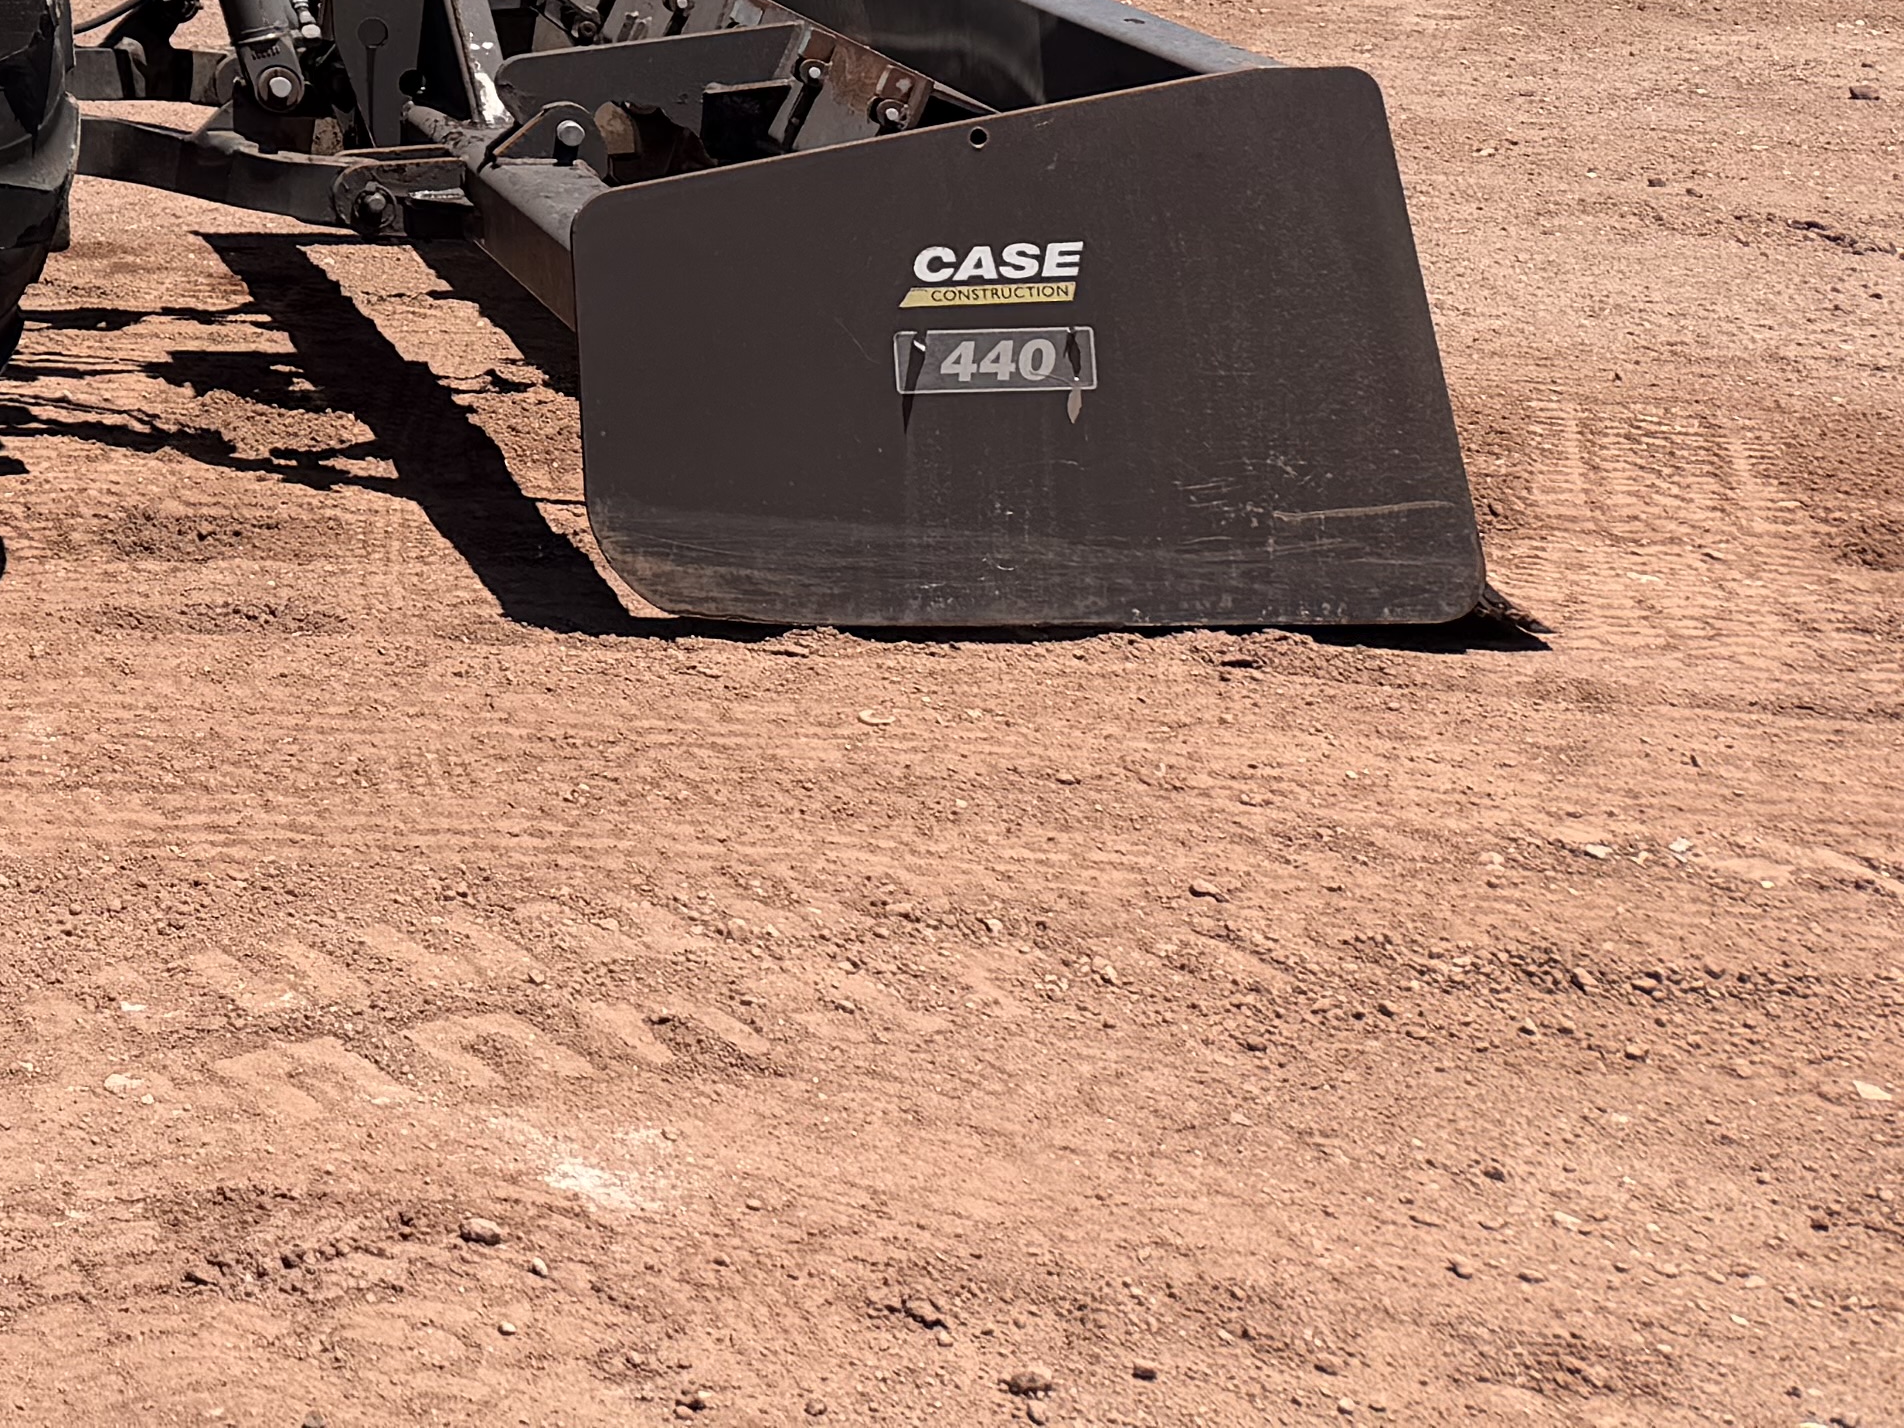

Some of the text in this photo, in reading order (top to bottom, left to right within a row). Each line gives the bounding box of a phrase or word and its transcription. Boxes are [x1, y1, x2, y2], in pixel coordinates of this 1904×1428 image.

[912, 241, 1084, 283] CASE
[930, 283, 1070, 303] CONSTRUCTION
[939, 337, 1057, 383] 440
